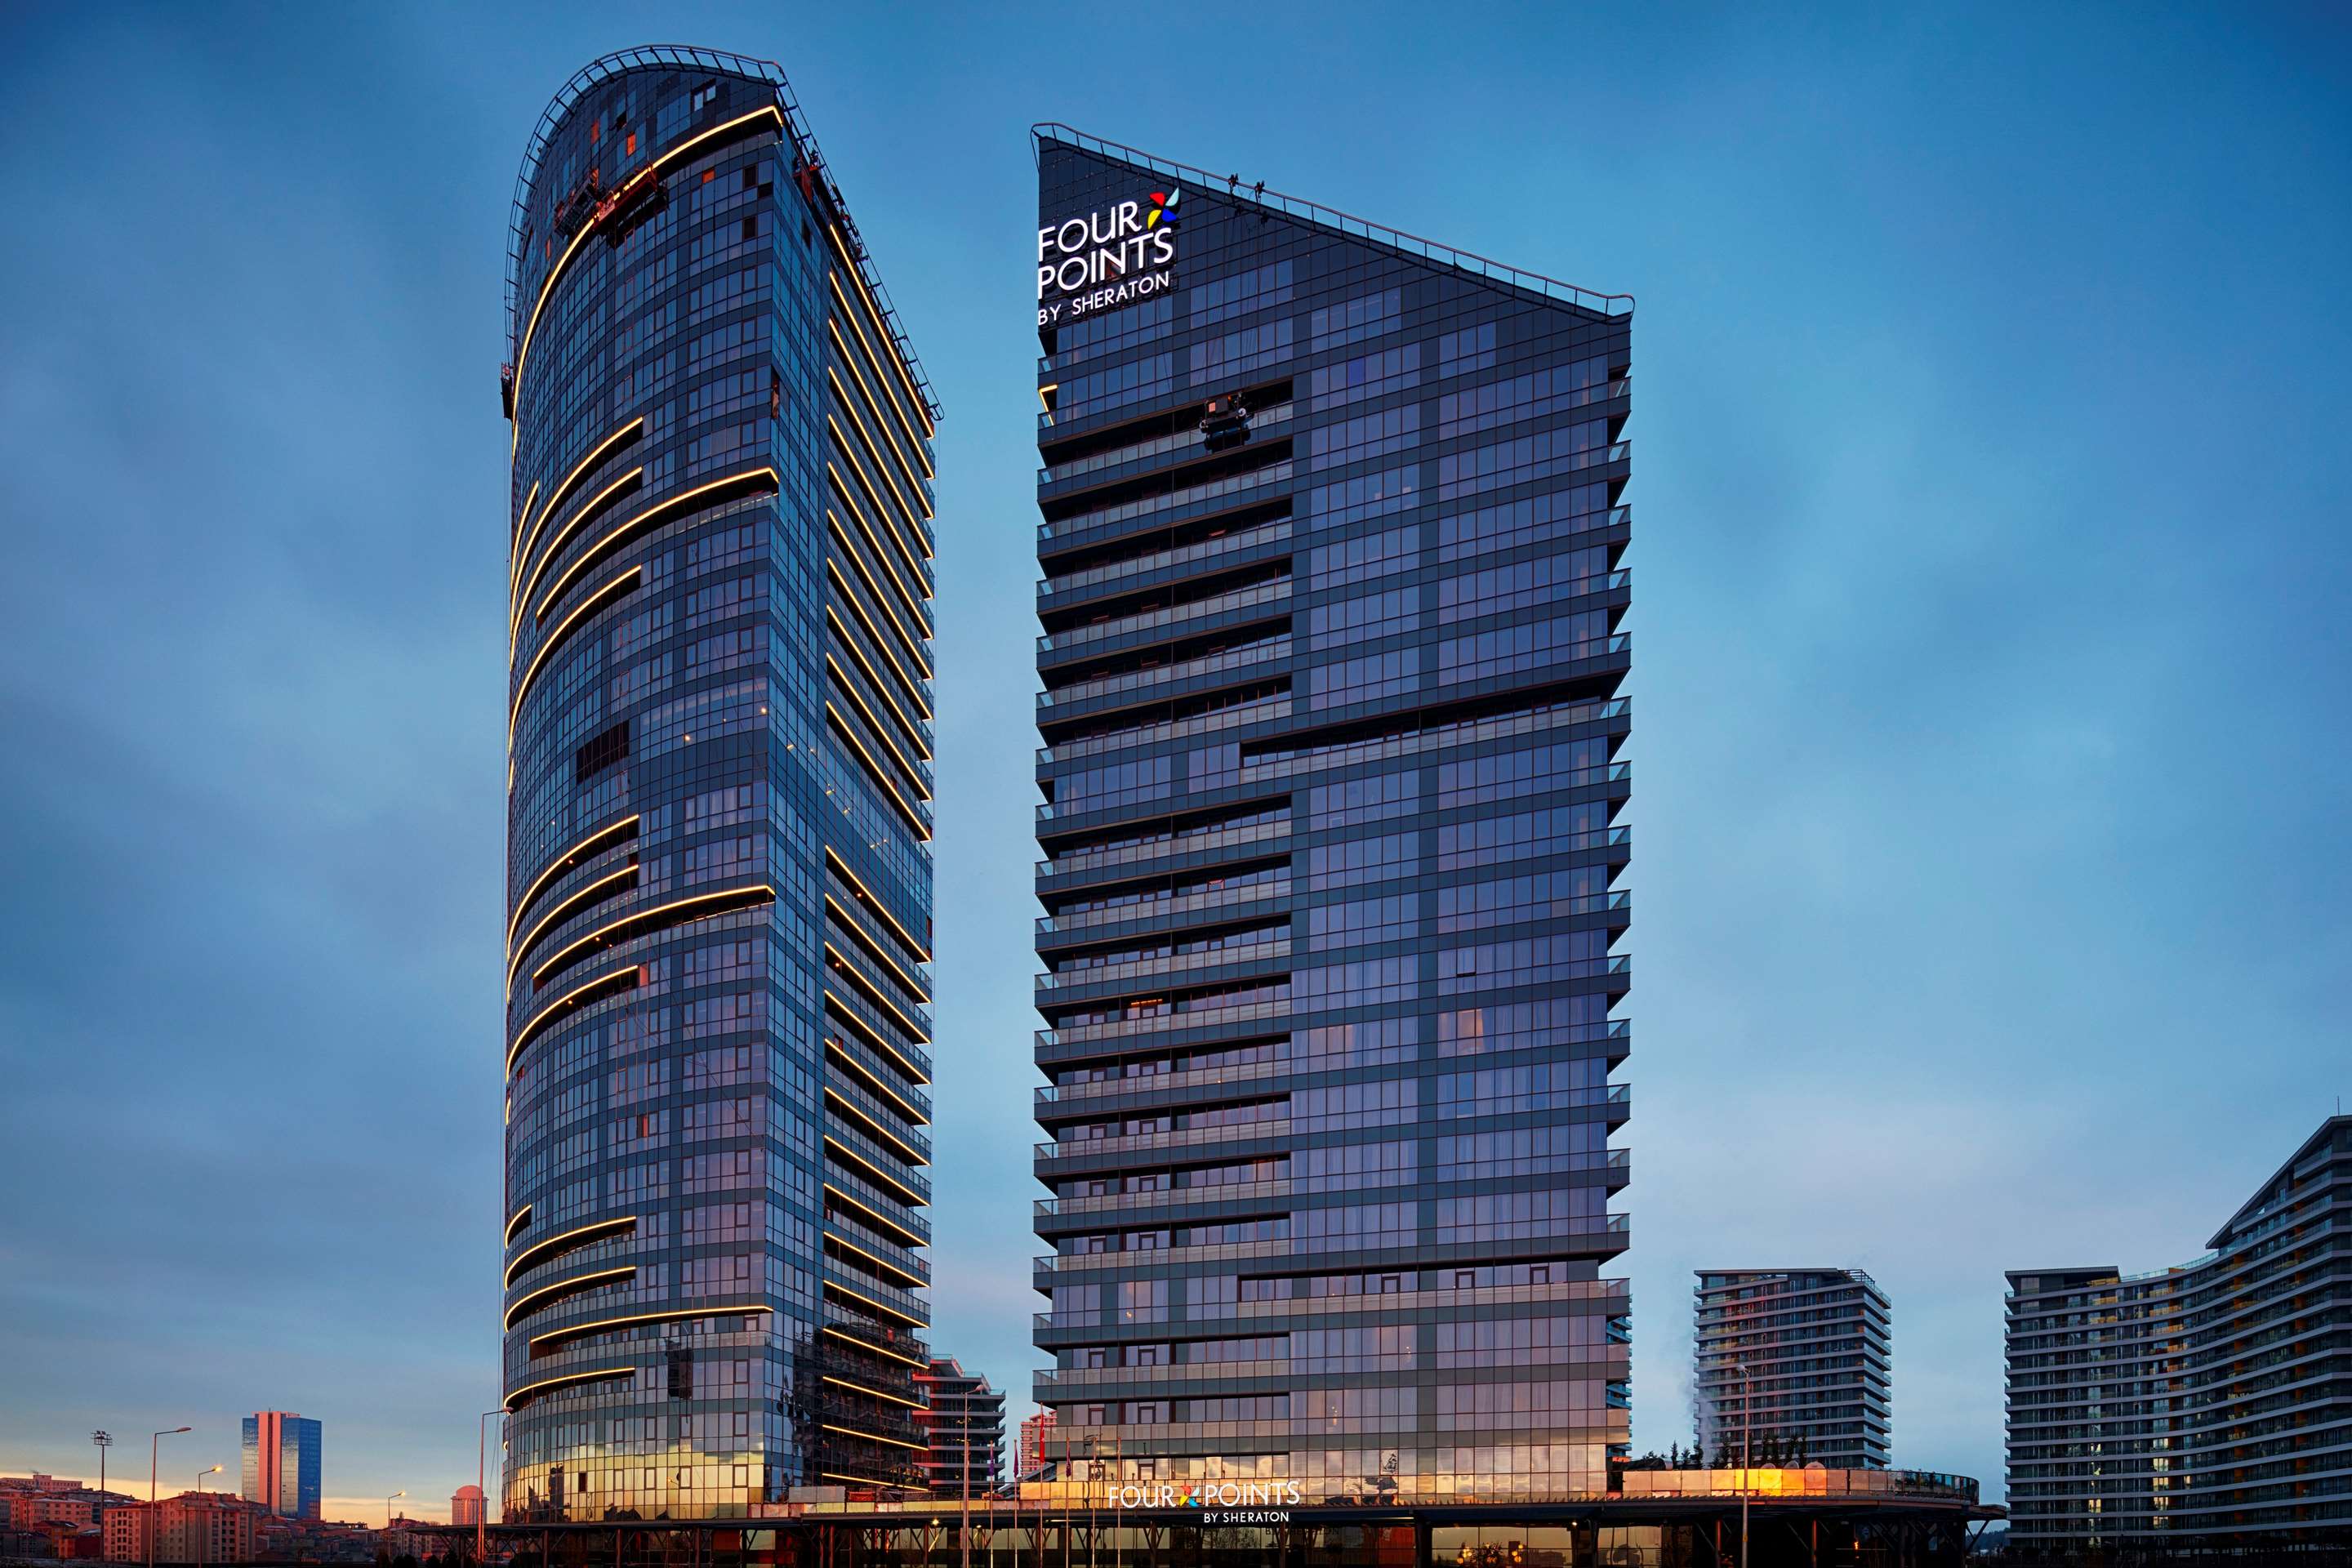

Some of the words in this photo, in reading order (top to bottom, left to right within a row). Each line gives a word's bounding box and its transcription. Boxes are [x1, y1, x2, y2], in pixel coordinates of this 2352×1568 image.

[1038, 200, 1143, 262] FOUR
[1037, 227, 1174, 300] POINTS
[1037, 304, 1062, 326] BY
[1072, 270, 1169, 315] SHERATON
[1109, 1486, 1177, 1508] FOUR
[1205, 1481, 1301, 1507] POINTS
[1204, 1512, 1218, 1523] BY
[1223, 1512, 1289, 1523] SHERATON
